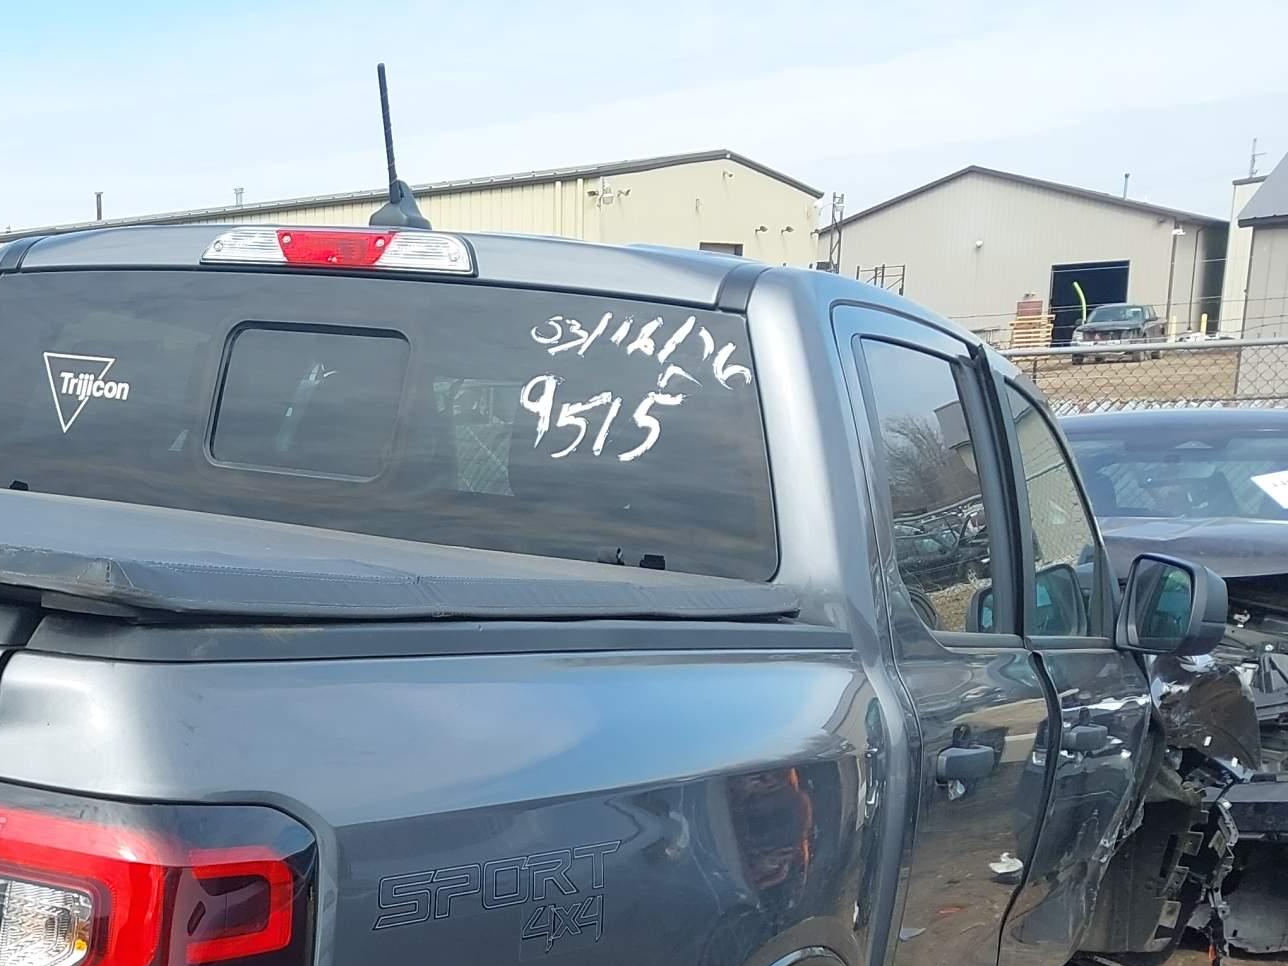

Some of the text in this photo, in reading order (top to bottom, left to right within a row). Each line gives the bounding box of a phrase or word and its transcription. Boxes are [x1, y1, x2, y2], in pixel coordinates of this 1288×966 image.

[60, 372, 130, 401] Trijicon
[520, 374, 687, 461] 9515
[372, 840, 622, 930] SPORT
